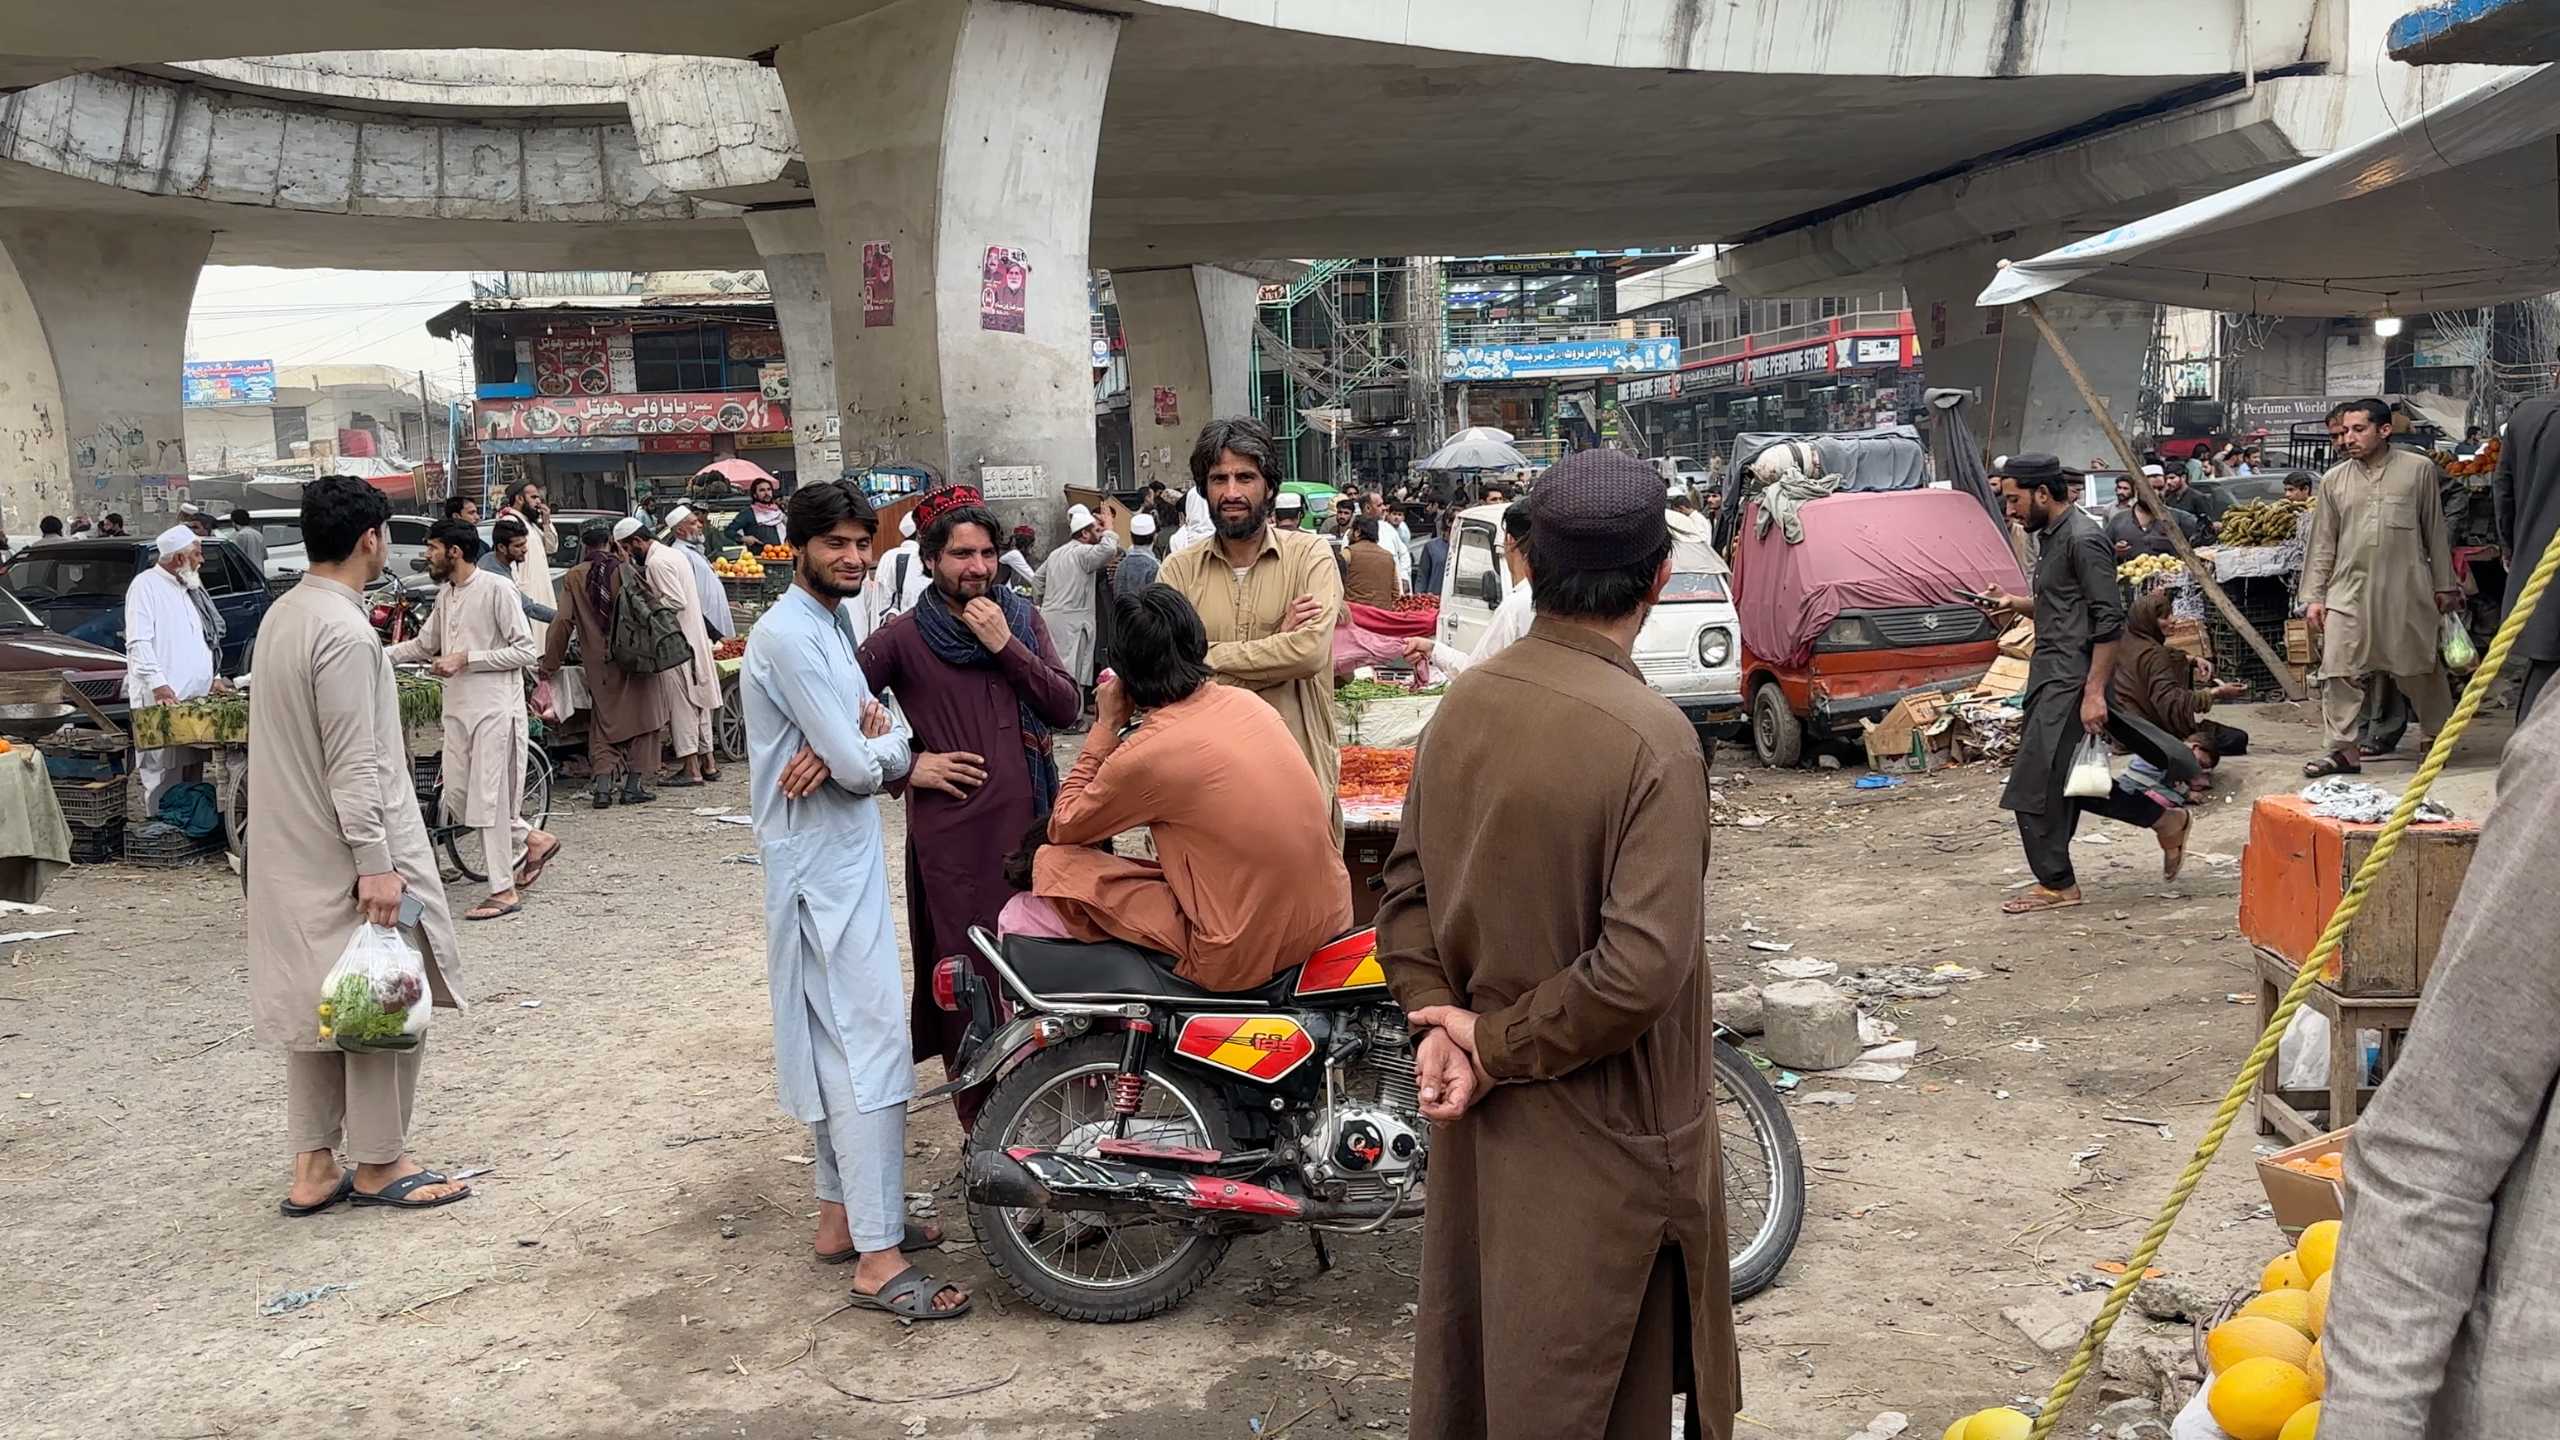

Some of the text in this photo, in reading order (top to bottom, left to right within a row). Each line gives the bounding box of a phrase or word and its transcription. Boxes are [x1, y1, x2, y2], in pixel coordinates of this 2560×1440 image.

[1747, 357, 1770, 381] PRIME
[1770, 350, 1804, 377] PERFUME
[1804, 345, 1828, 370] STORE
[659, 397, 688, 418] بابا
[2243, 402, 2291, 415] Perfume
[2294, 400, 2327, 413] World
